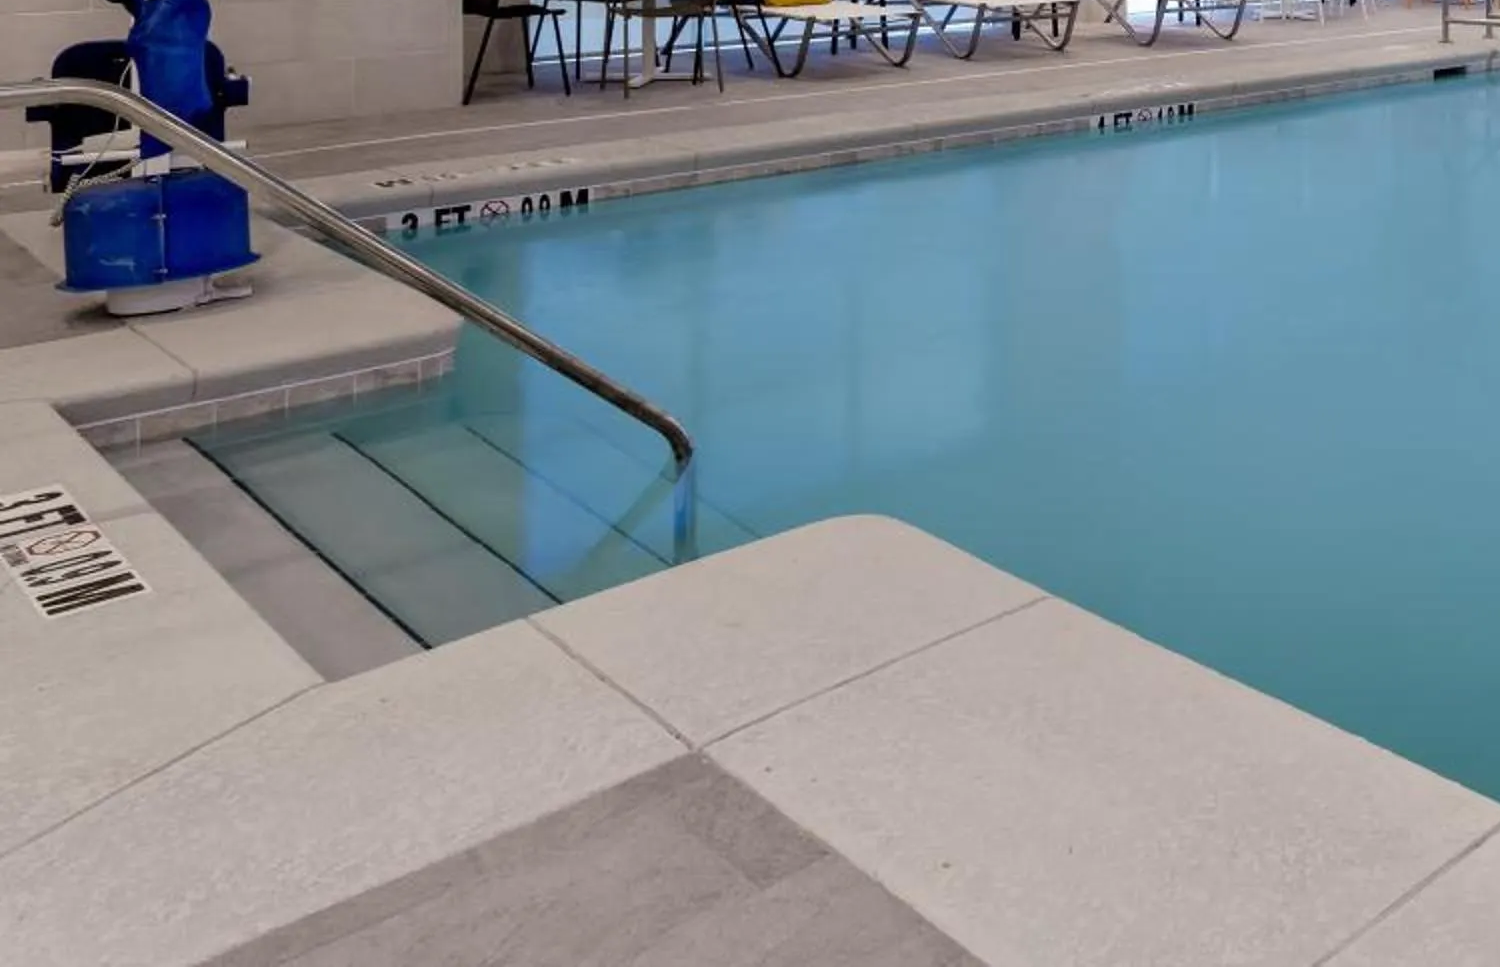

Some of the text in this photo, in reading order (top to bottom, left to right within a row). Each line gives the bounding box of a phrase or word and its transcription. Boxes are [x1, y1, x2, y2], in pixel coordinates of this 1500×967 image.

[434, 204, 471, 227] FT
[0, 492, 64, 511] 3
[0, 504, 87, 539] FT
